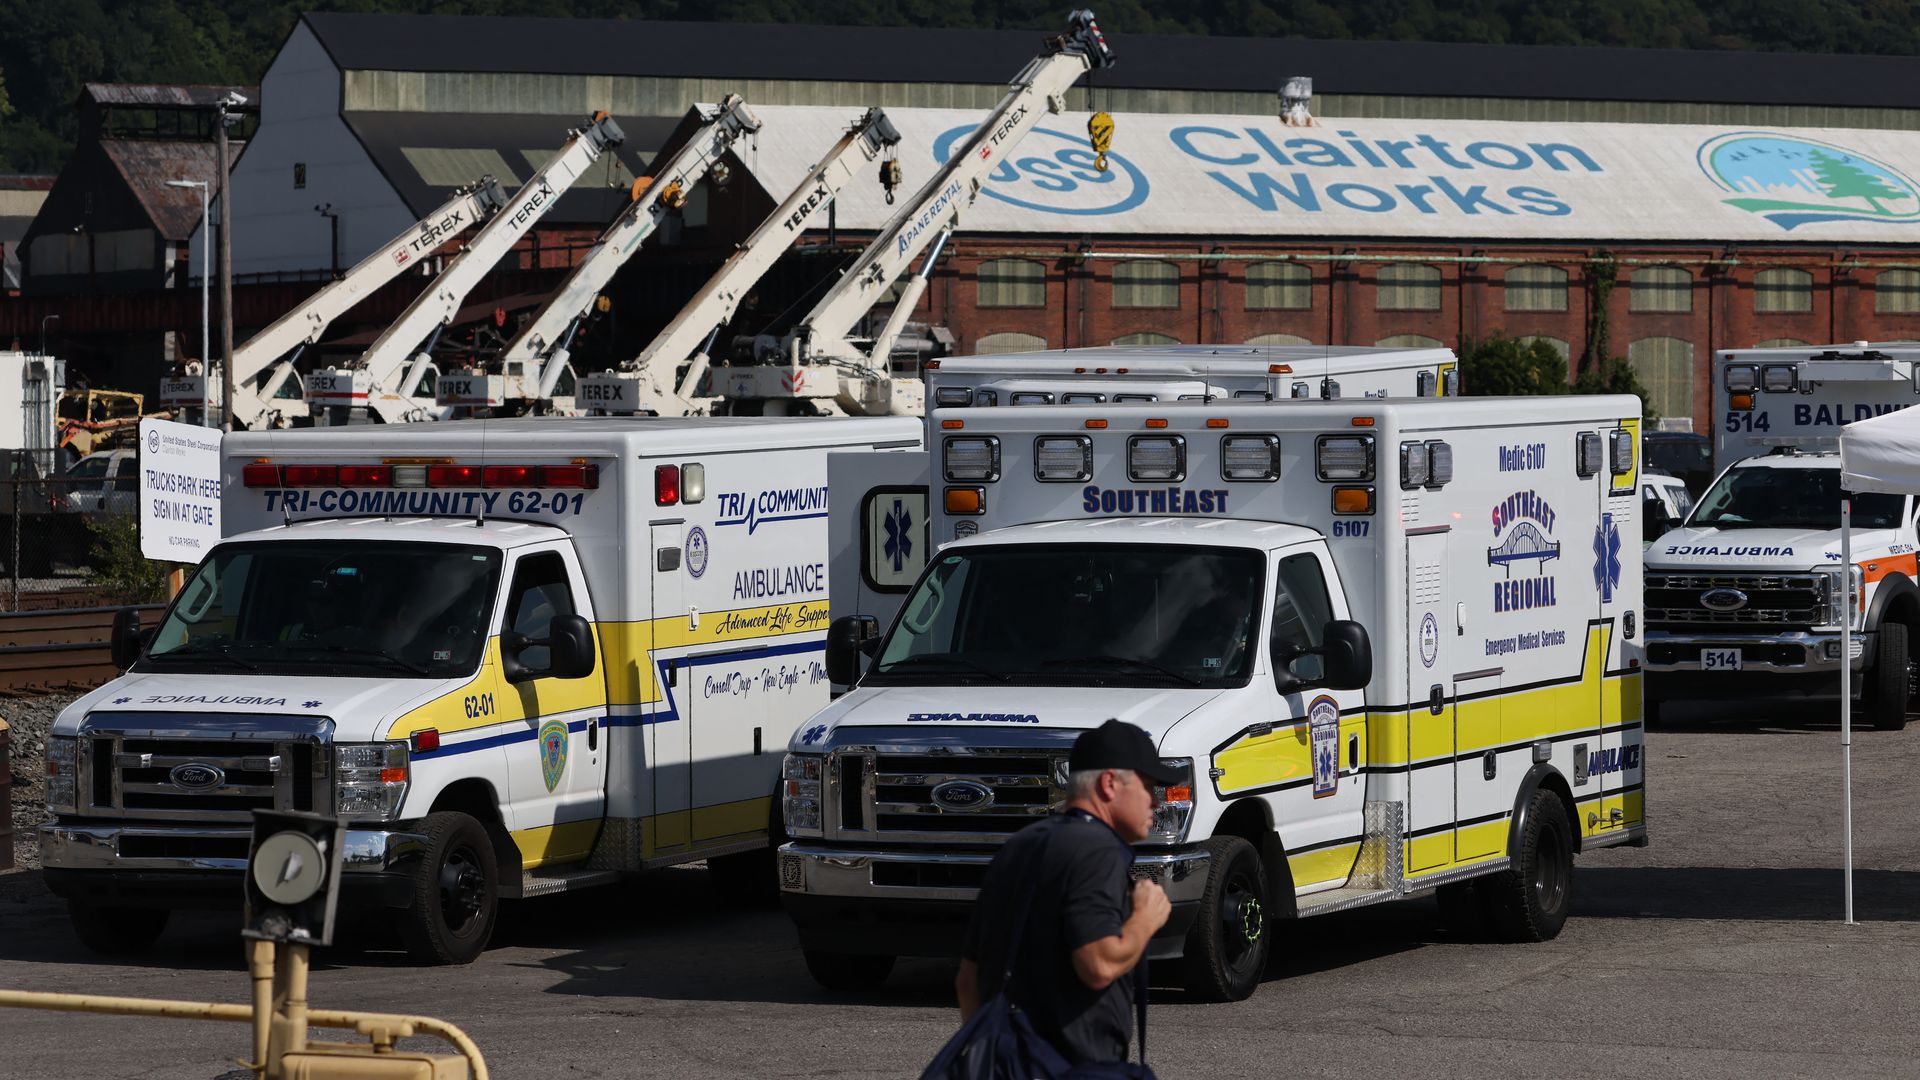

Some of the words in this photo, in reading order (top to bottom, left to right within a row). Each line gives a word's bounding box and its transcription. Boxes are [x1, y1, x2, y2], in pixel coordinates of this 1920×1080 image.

[990, 104, 1029, 146] TEREX
[1169, 125, 1604, 173] Clairton
[508, 184, 552, 231] TEREX
[784, 184, 828, 232] TEREX
[930, 179, 962, 219] RENTAL
[1204, 171, 1574, 217] Works
[409, 211, 464, 252] TEREX
[167, 382, 195, 393] TEREX
[439, 380, 472, 396] TEREX
[582, 384, 623, 401] TEREX
[1725, 411, 1770, 433] 514
[1794, 403, 1911, 426] BALD
[175, 437, 187, 447] States
[1499, 444, 1525, 472] Medic
[1527, 443, 1546, 471] 6107
[146, 469, 176, 493] TRUCKS
[178, 474, 198, 497] PARK
[199, 478, 221, 500] HERE
[153, 498, 171, 519] SIGN
[172, 502, 180, 521] IN
[181, 503, 191, 523] AT
[193, 505, 213, 526] GATE
[263, 489, 501, 514] TRI-COMMUNITY
[508, 491, 585, 515] 62-01
[717, 492, 746, 517] TRI
[1333, 520, 1370, 538] 6107
[733, 563, 824, 601] AMBULANCE
[1494, 575, 1557, 613] REGIONAL
[715, 611, 770, 635] Advanced
[769, 606, 793, 633] Life
[1485, 637, 1517, 656] Emergency
[1518, 631, 1540, 651] Medical
[1541, 629, 1566, 647] Services
[1705, 651, 1737, 668] 514
[704, 671, 733, 699] Carroll
[761, 667, 778, 692] New
[778, 665, 800, 695] Eagle
[465, 692, 495, 719] 62-01
[1587, 743, 1640, 777] AMBULANCE
